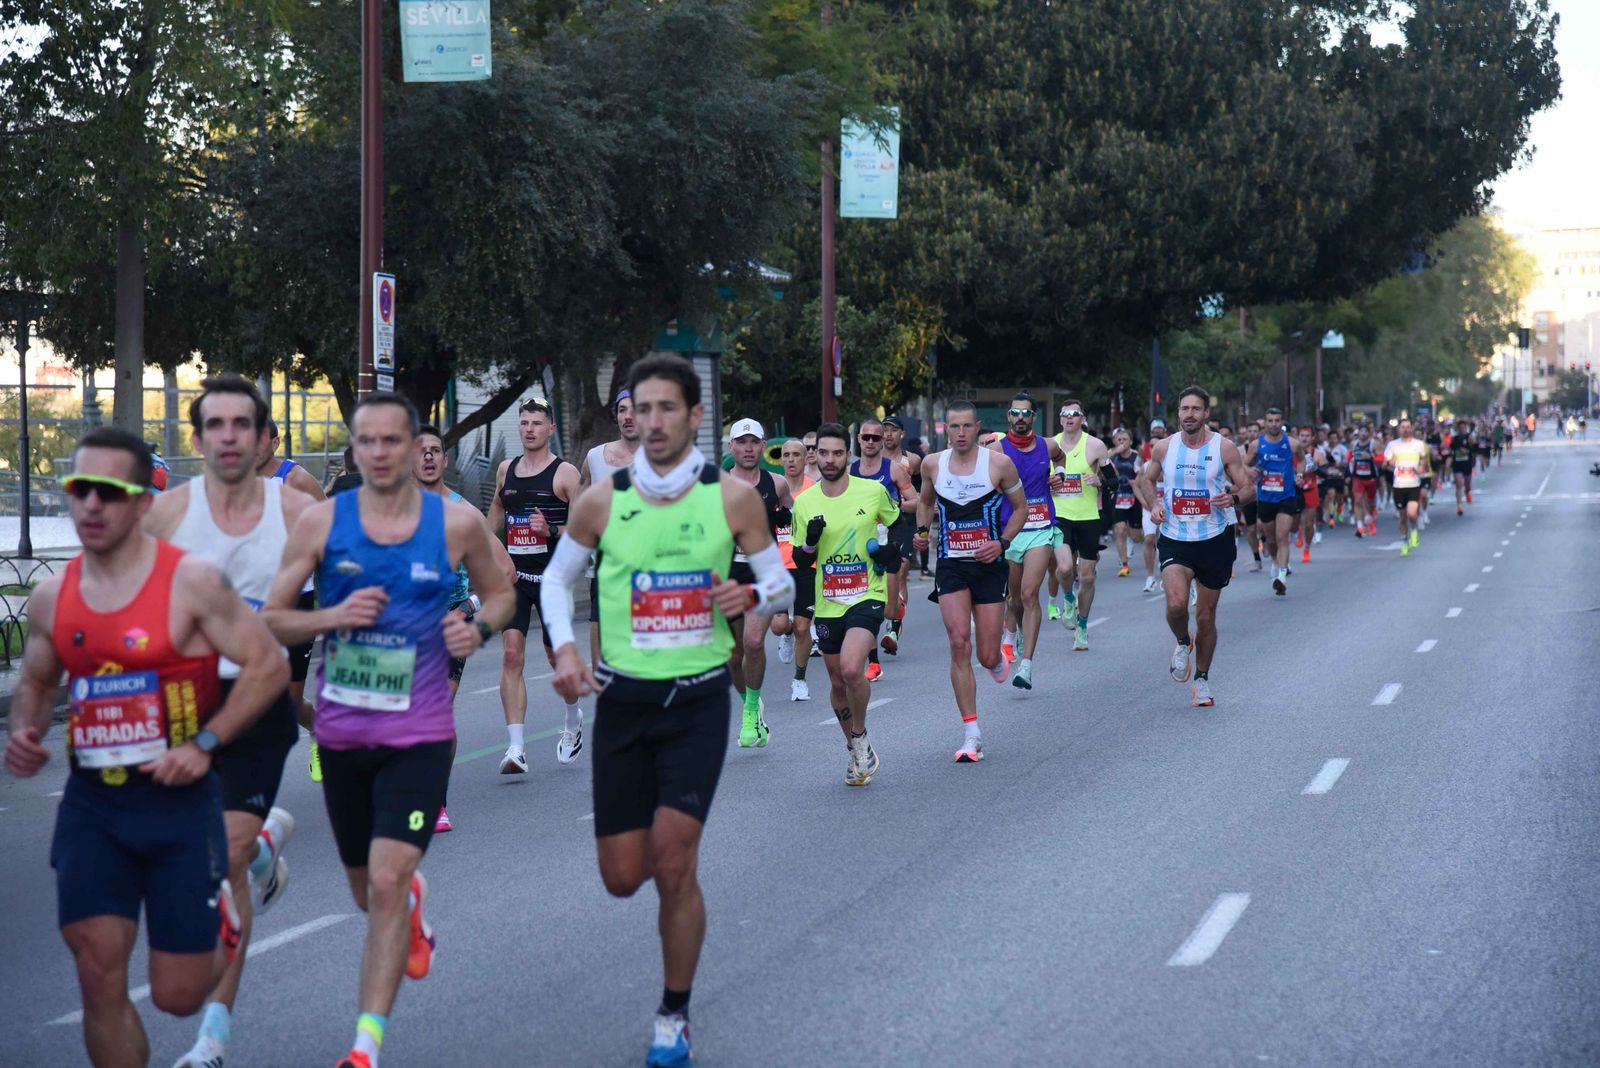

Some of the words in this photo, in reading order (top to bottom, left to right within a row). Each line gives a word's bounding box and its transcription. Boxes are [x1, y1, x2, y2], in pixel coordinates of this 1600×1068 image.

[407, 8, 486, 25] SEVILLA
[657, 574, 703, 587] ZURICH
[356, 632, 407, 645] ZURICH
[93, 677, 146, 694] ZURICH
[331, 667, 370, 687] JEAN
[74, 720, 160, 745] R.PRADAS
